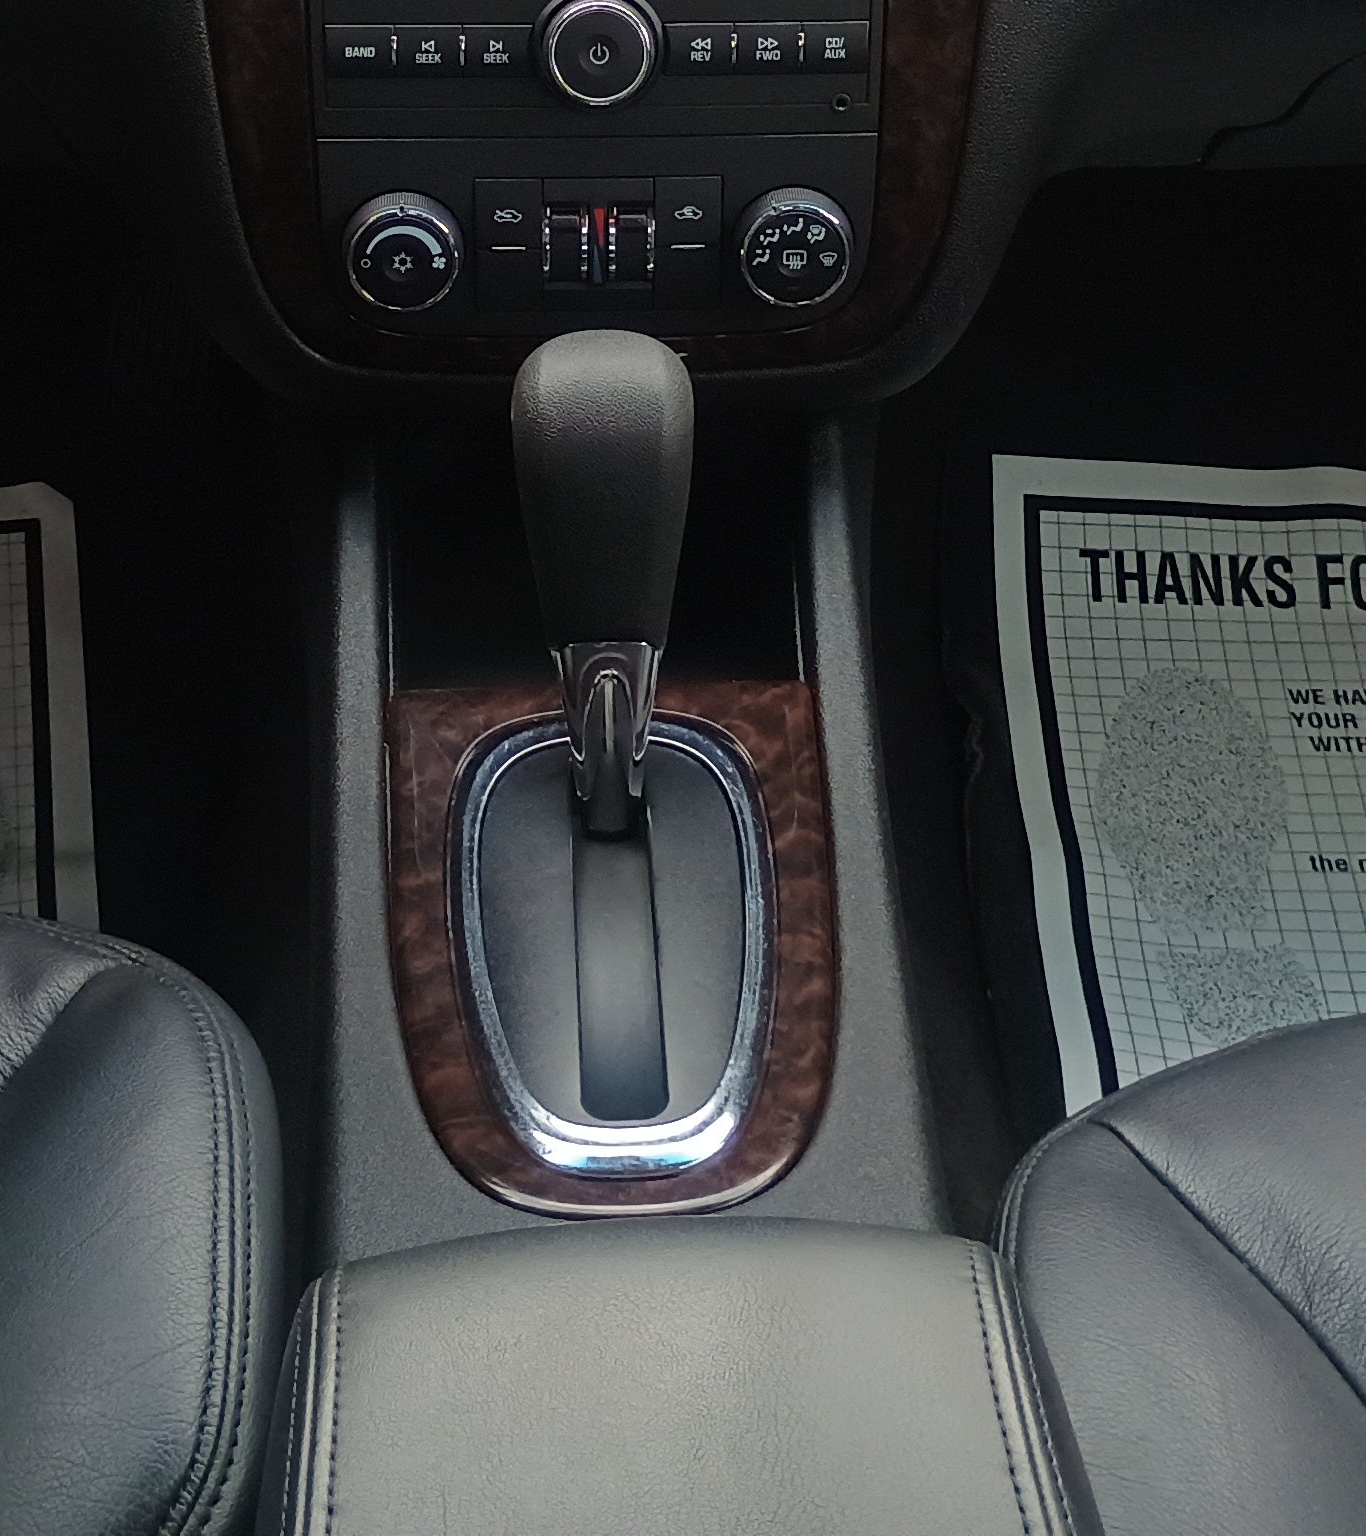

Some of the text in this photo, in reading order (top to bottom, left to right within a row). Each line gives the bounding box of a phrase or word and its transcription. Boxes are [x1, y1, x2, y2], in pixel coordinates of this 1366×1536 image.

[825, 37, 845, 48] CD/
[345, 46, 376, 58] BAND
[690, 51, 712, 62] REV
[756, 50, 781, 61] FWD
[824, 49, 846, 59] AUX
[415, 53, 441, 64] SEEK
[483, 53, 510, 64] SEEK
[1079, 548, 1298, 610] THANKS
[1287, 688, 1327, 706] WE
[1289, 711, 1359, 730] YOUR
[1309, 854, 1350, 874] the
